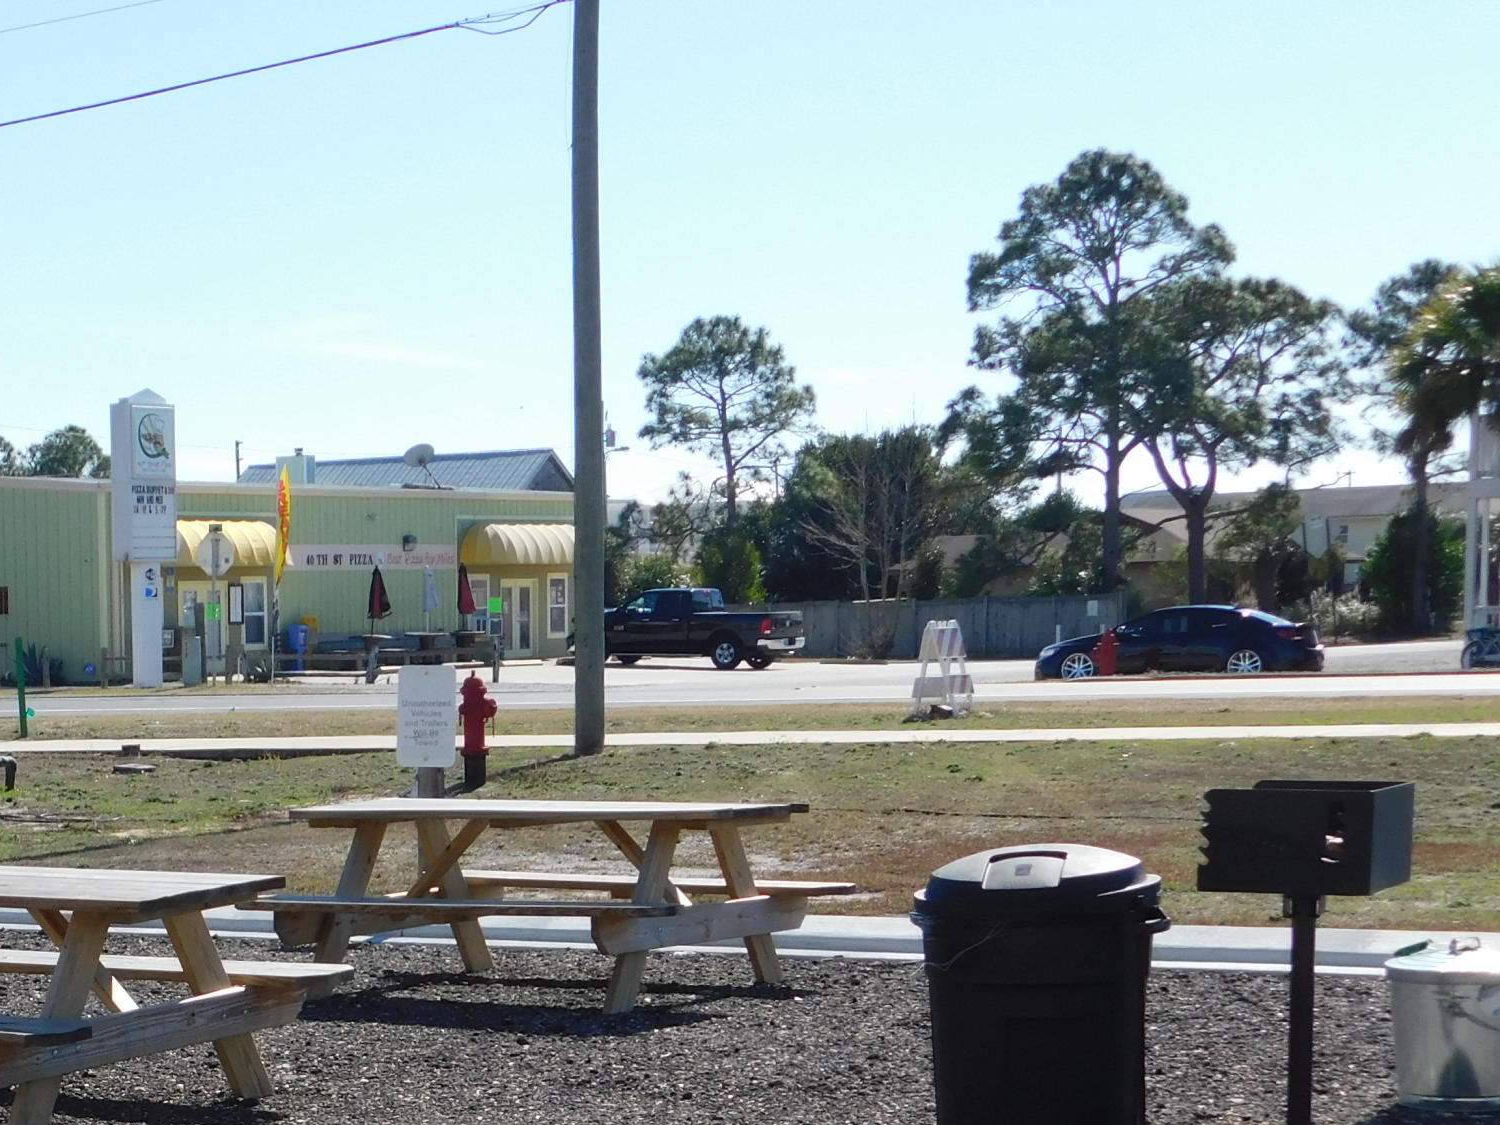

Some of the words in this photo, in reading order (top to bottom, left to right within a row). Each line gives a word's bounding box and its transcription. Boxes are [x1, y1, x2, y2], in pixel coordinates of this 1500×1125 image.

[131, 485, 146, 494] PIZZA
[146, 485, 164, 495] BUFFET
[146, 495, 154, 504] AND
[316, 553, 328, 566] TH
[333, 553, 343, 566] ST
[349, 553, 374, 566] PIZZA
[404, 719, 419, 727] and
[420, 719, 449, 727] Trailers
[414, 738, 439, 746] Towed
